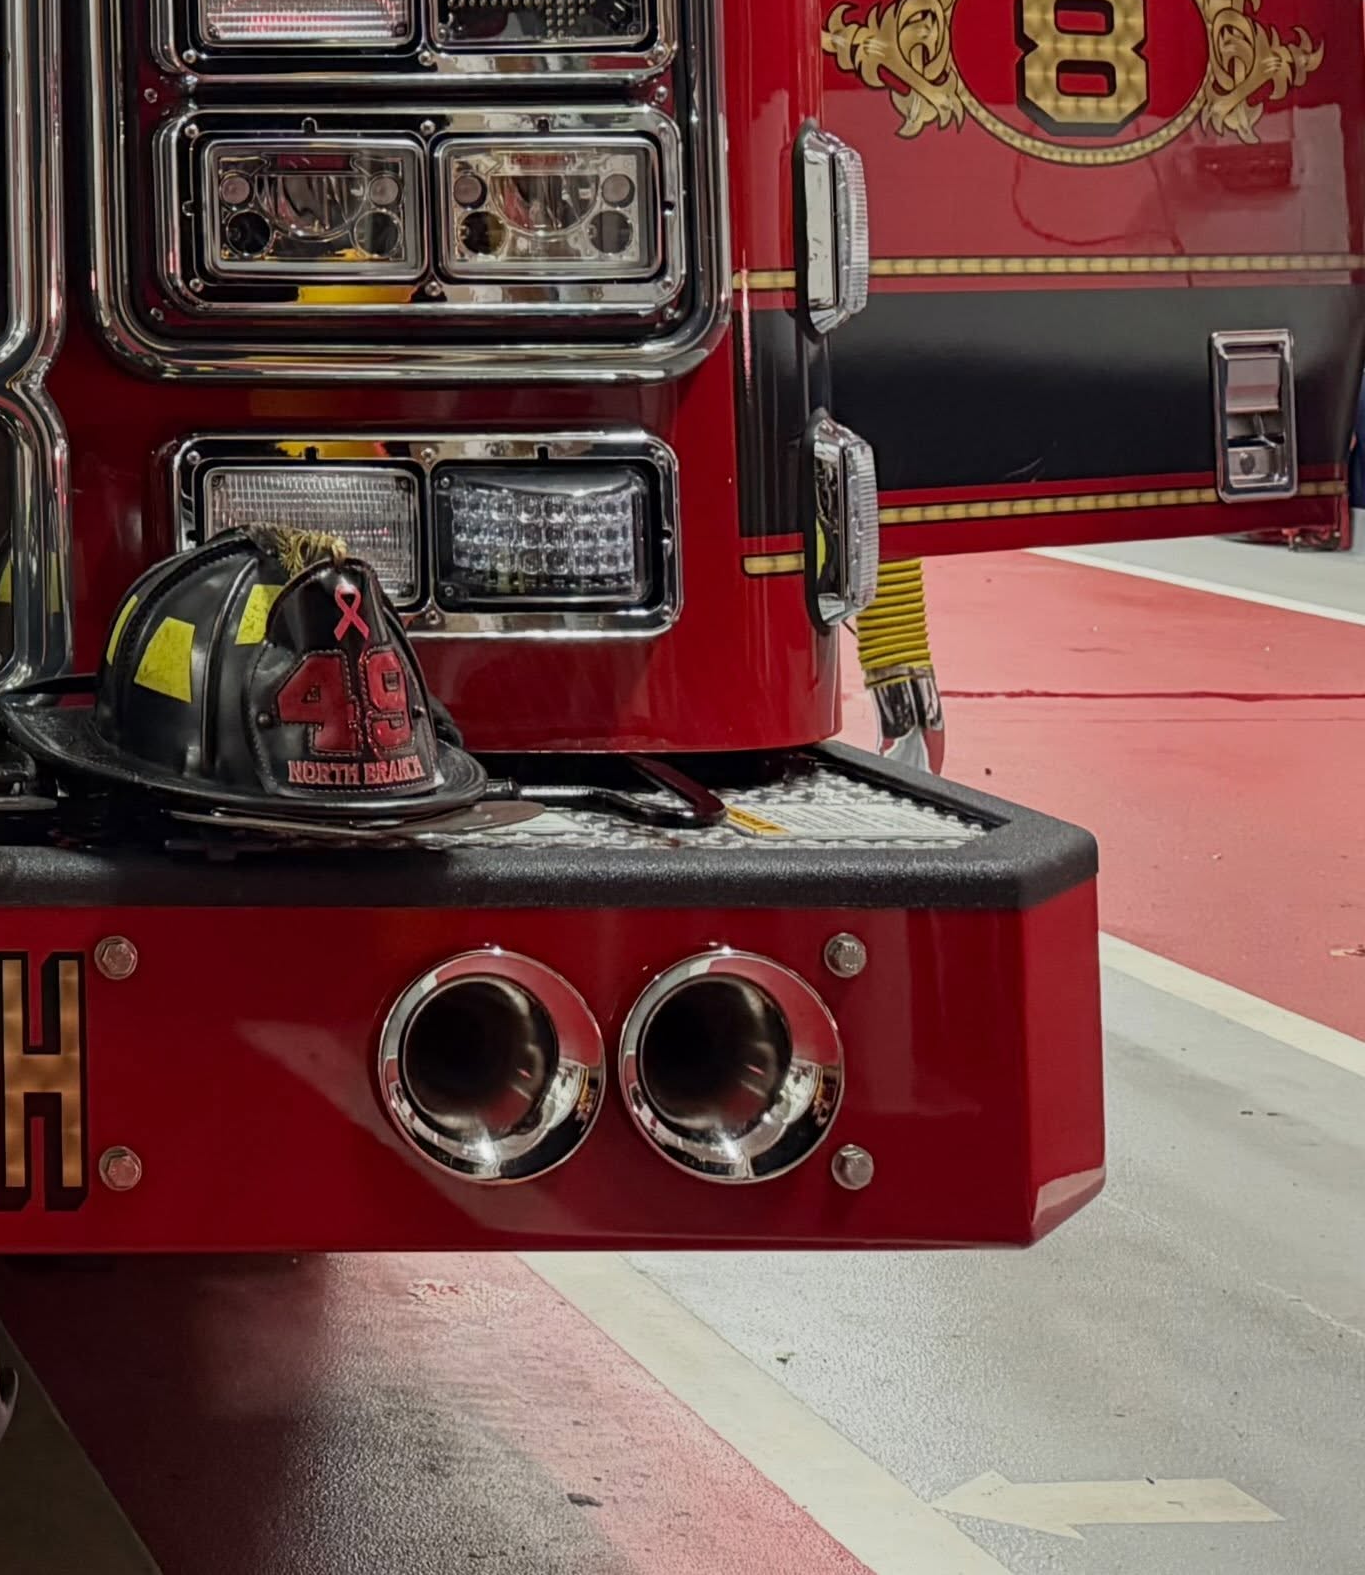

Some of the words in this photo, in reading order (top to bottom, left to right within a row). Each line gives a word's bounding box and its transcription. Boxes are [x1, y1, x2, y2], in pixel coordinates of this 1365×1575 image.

[277, 648, 412, 756] 49
[287, 760, 360, 785] NORTH
[362, 755, 425, 785] BRANCH
